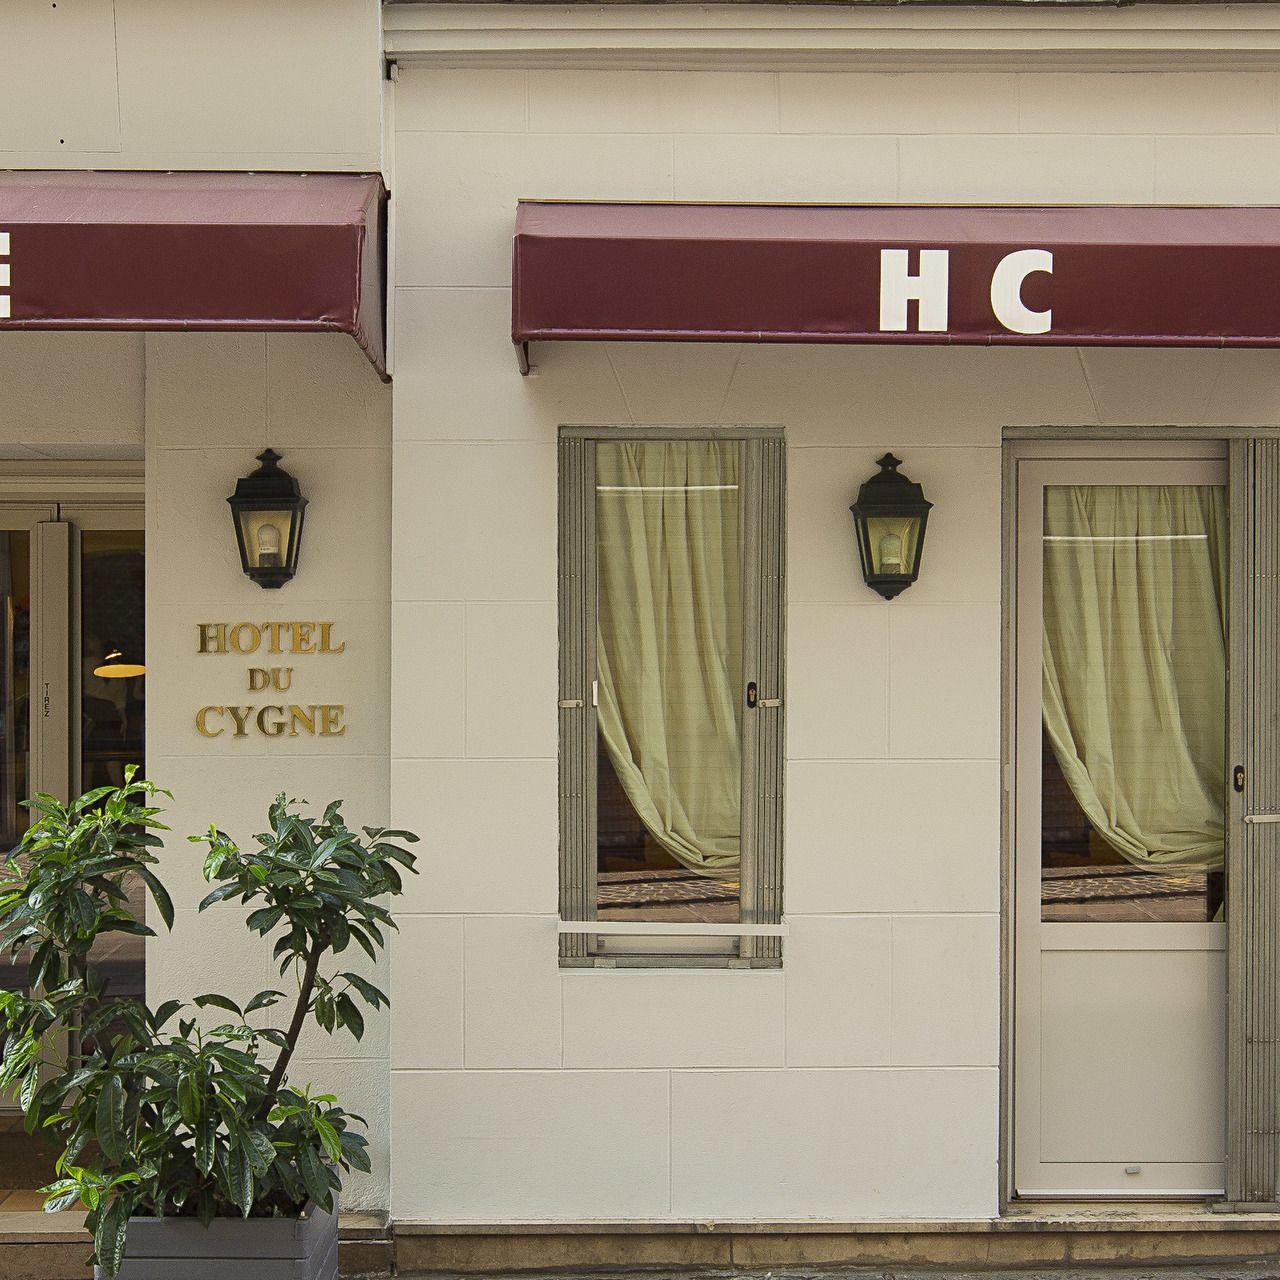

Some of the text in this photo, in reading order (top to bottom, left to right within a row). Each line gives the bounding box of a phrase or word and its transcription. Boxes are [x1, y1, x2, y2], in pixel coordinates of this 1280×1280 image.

[196, 622, 346, 654] HOTEL
[247, 666, 293, 692] DU
[195, 704, 346, 737] CYGNE
